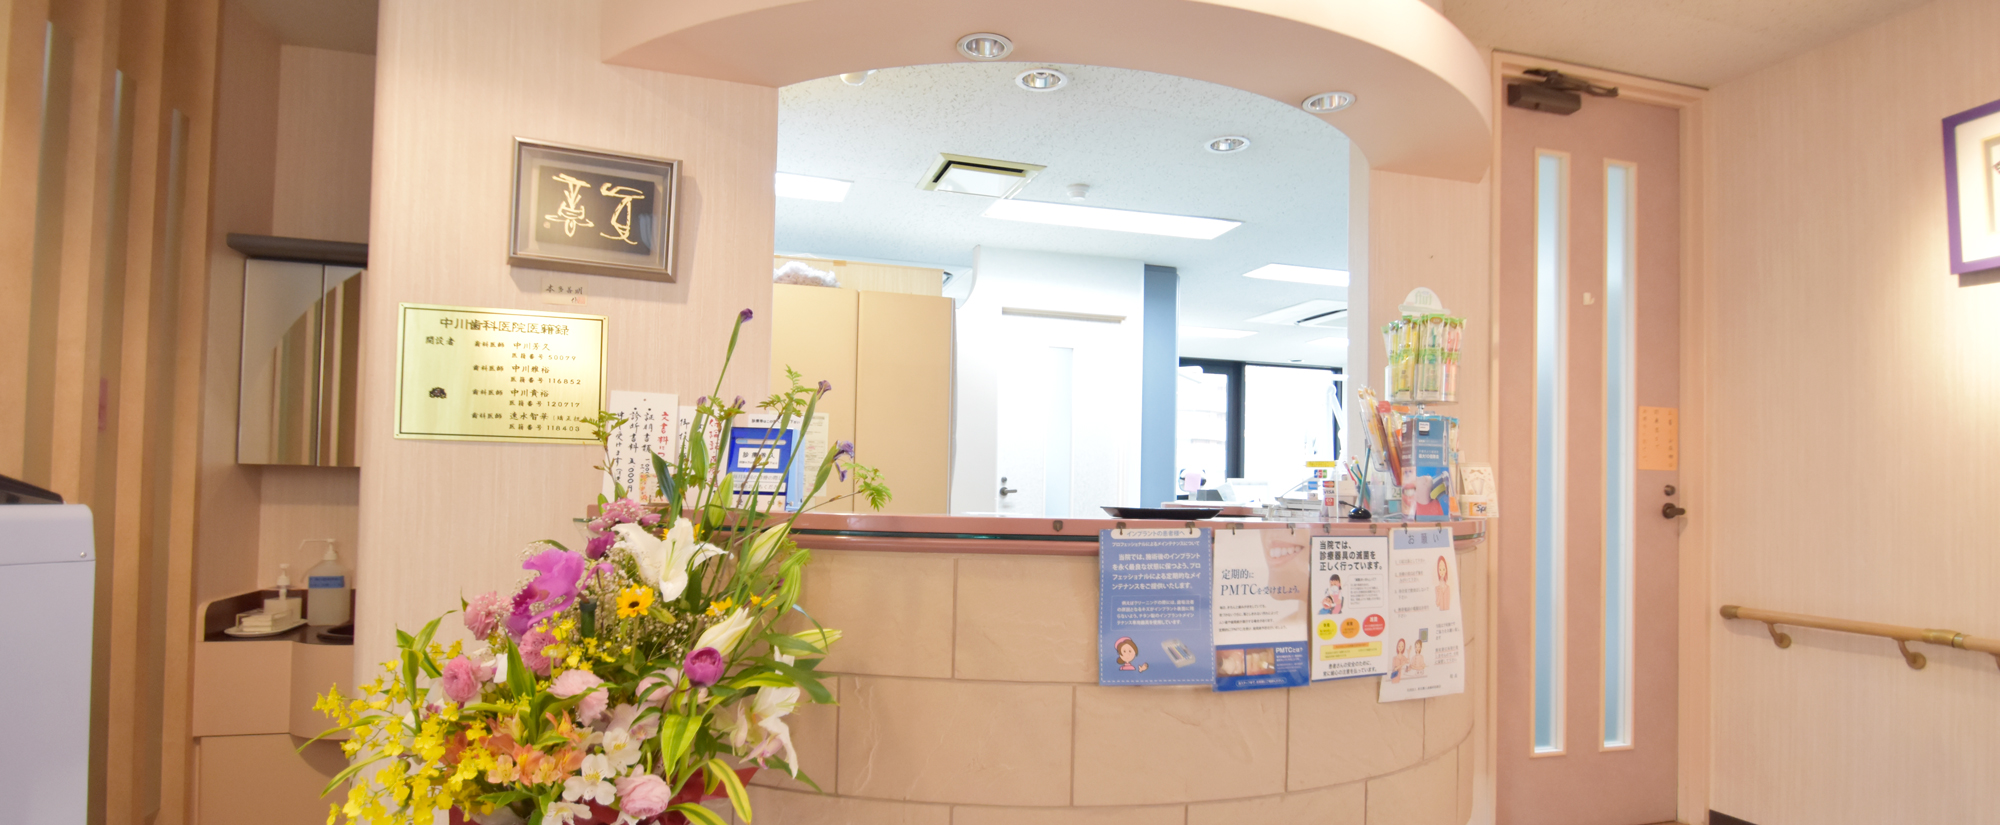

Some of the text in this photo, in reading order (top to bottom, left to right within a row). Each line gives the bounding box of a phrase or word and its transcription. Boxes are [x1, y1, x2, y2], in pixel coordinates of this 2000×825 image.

[440, 317, 570, 336] 中川歯科医院医籍録
[425, 336, 455, 346] 開設者
[475, 340, 505, 348] 歯科医師
[472, 364, 504, 372] 歯科医師
[471, 412, 502, 420] 歯科医師
[1408, 532, 1440, 545] お願い
[1320, 540, 1352, 550] 当院では、
[1118, 552, 1200, 561] 当院では、施術後のインプラント
[1320, 550, 1376, 560] 診療器具の滅菌を
[1320, 562, 1382, 571] 正しく行っています。
[1112, 572, 1201, 580] フェッショナルによる定期的なメイ
[1221, 568, 1254, 580] 定期的に
[1220, 584, 1300, 596] PMTCを受けましょう。
